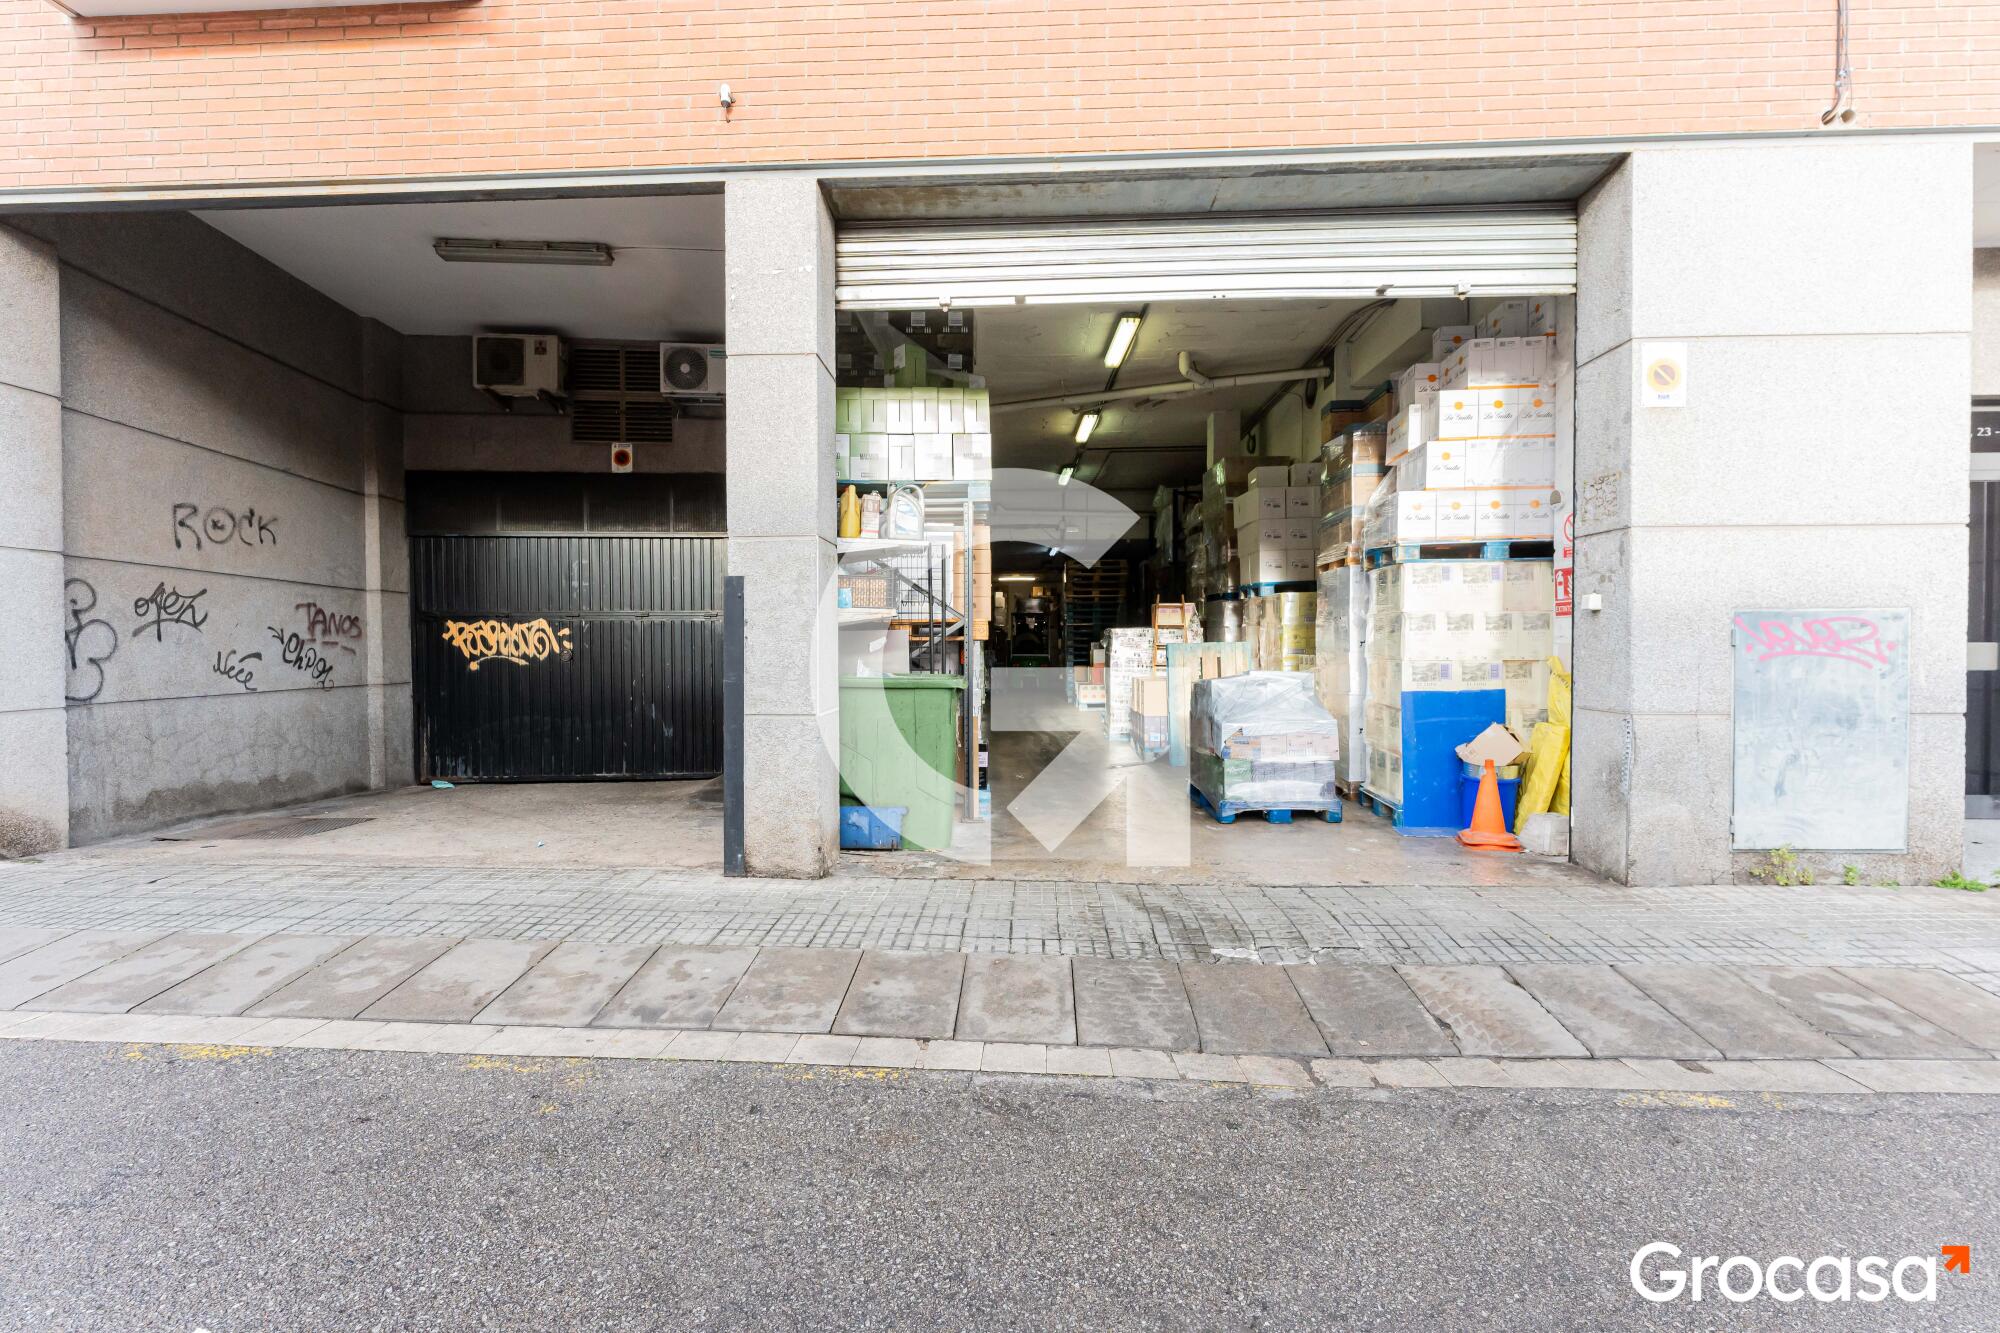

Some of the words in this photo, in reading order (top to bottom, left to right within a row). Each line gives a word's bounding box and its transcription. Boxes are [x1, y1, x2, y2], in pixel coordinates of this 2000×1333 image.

[1976, 427, 1991, 436] 23
[173, 502, 278, 550] ROCK
[295, 602, 363, 640] TANOS
